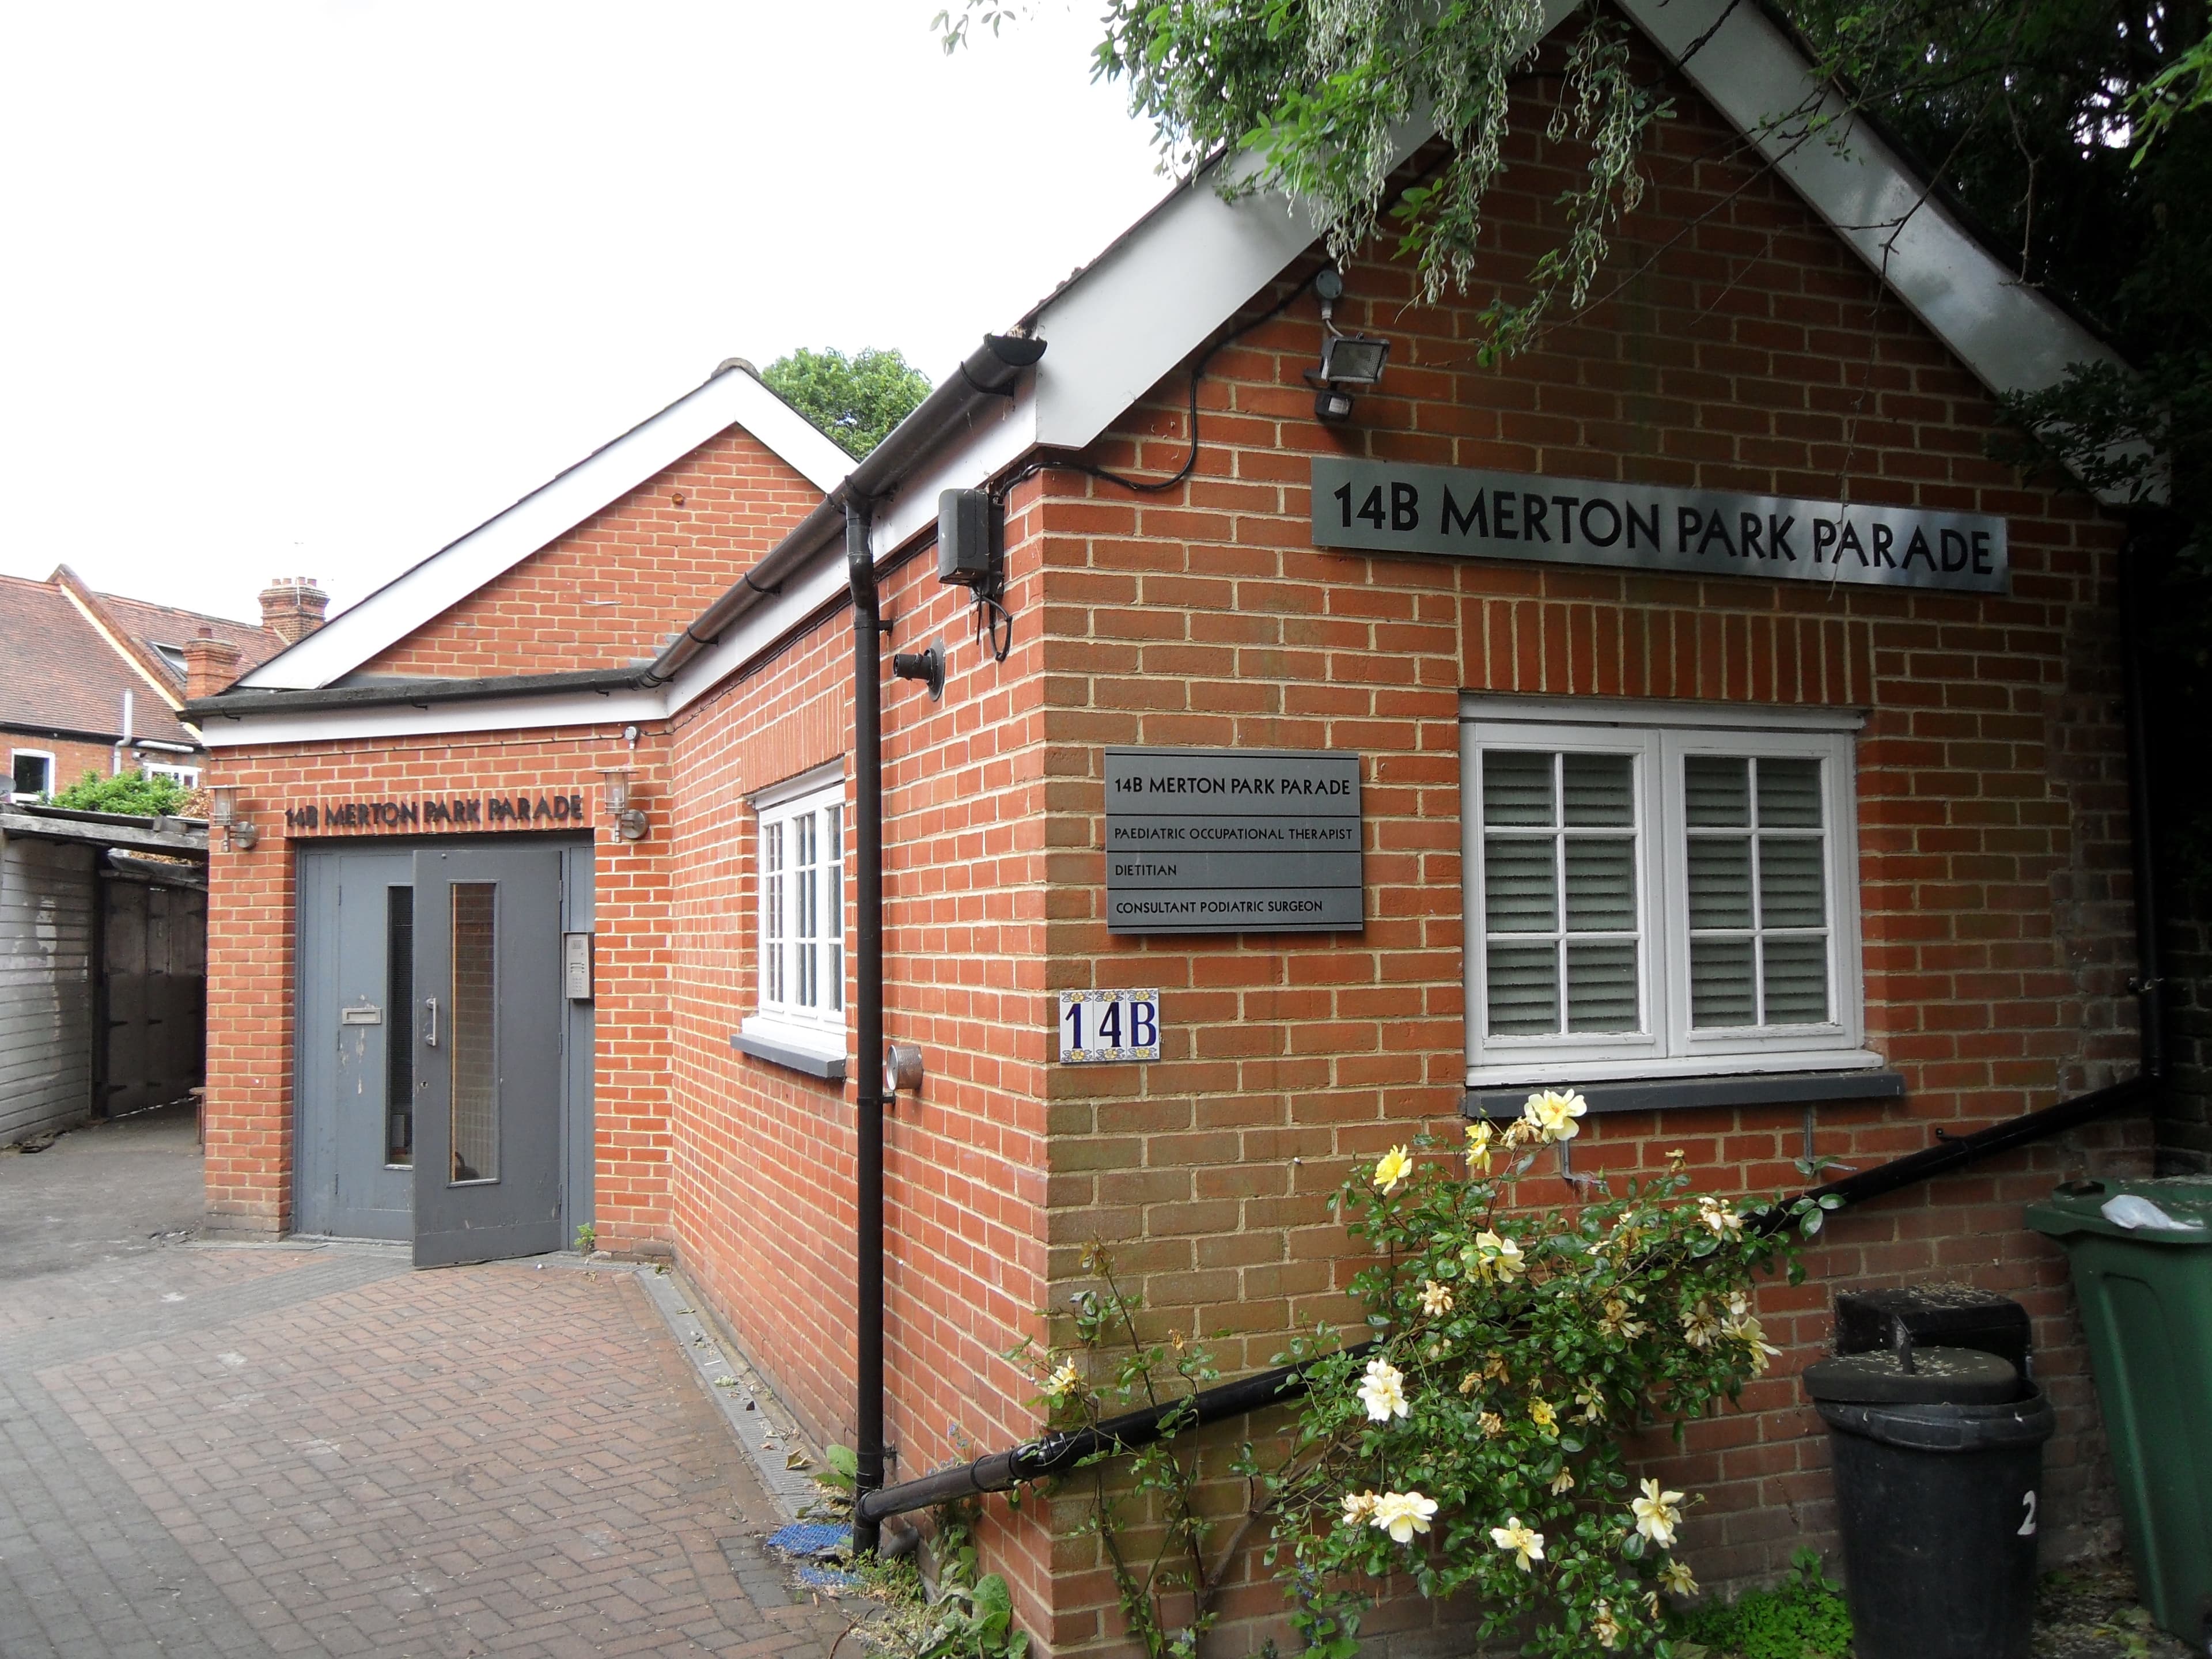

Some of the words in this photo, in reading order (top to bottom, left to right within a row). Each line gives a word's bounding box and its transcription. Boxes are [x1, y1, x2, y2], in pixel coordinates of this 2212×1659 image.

[1333, 480, 1419, 531] 14B
[1440, 484, 1660, 552] MERTON
[1677, 506, 1796, 562] PARK
[1813, 518, 1994, 575] PARADE
[1115, 777, 1142, 793] 14B
[1149, 777, 1225, 794] MERTON
[1231, 778, 1275, 794] PARK
[1281, 779, 1351, 795] PARADE
[285, 805, 318, 828] 14B
[324, 801, 418, 827] MERTON
[423, 798, 481, 824] PARK
[488, 794, 583, 821] PARADE
[1115, 828, 1185, 840] PAEDIATRIC
[1189, 828, 1284, 840] OCCUPATIONAL
[1289, 828, 1352, 840] THERAPIST
[1115, 865, 1177, 876] DIETITIAN
[1116, 902, 1196, 914] CONSULTANT
[1200, 900, 1264, 913] PODIATRIC
[1267, 900, 1323, 912] SURGEON
[1065, 1001, 1157, 1050] 14B
[2017, 1490, 2036, 1535] 2
